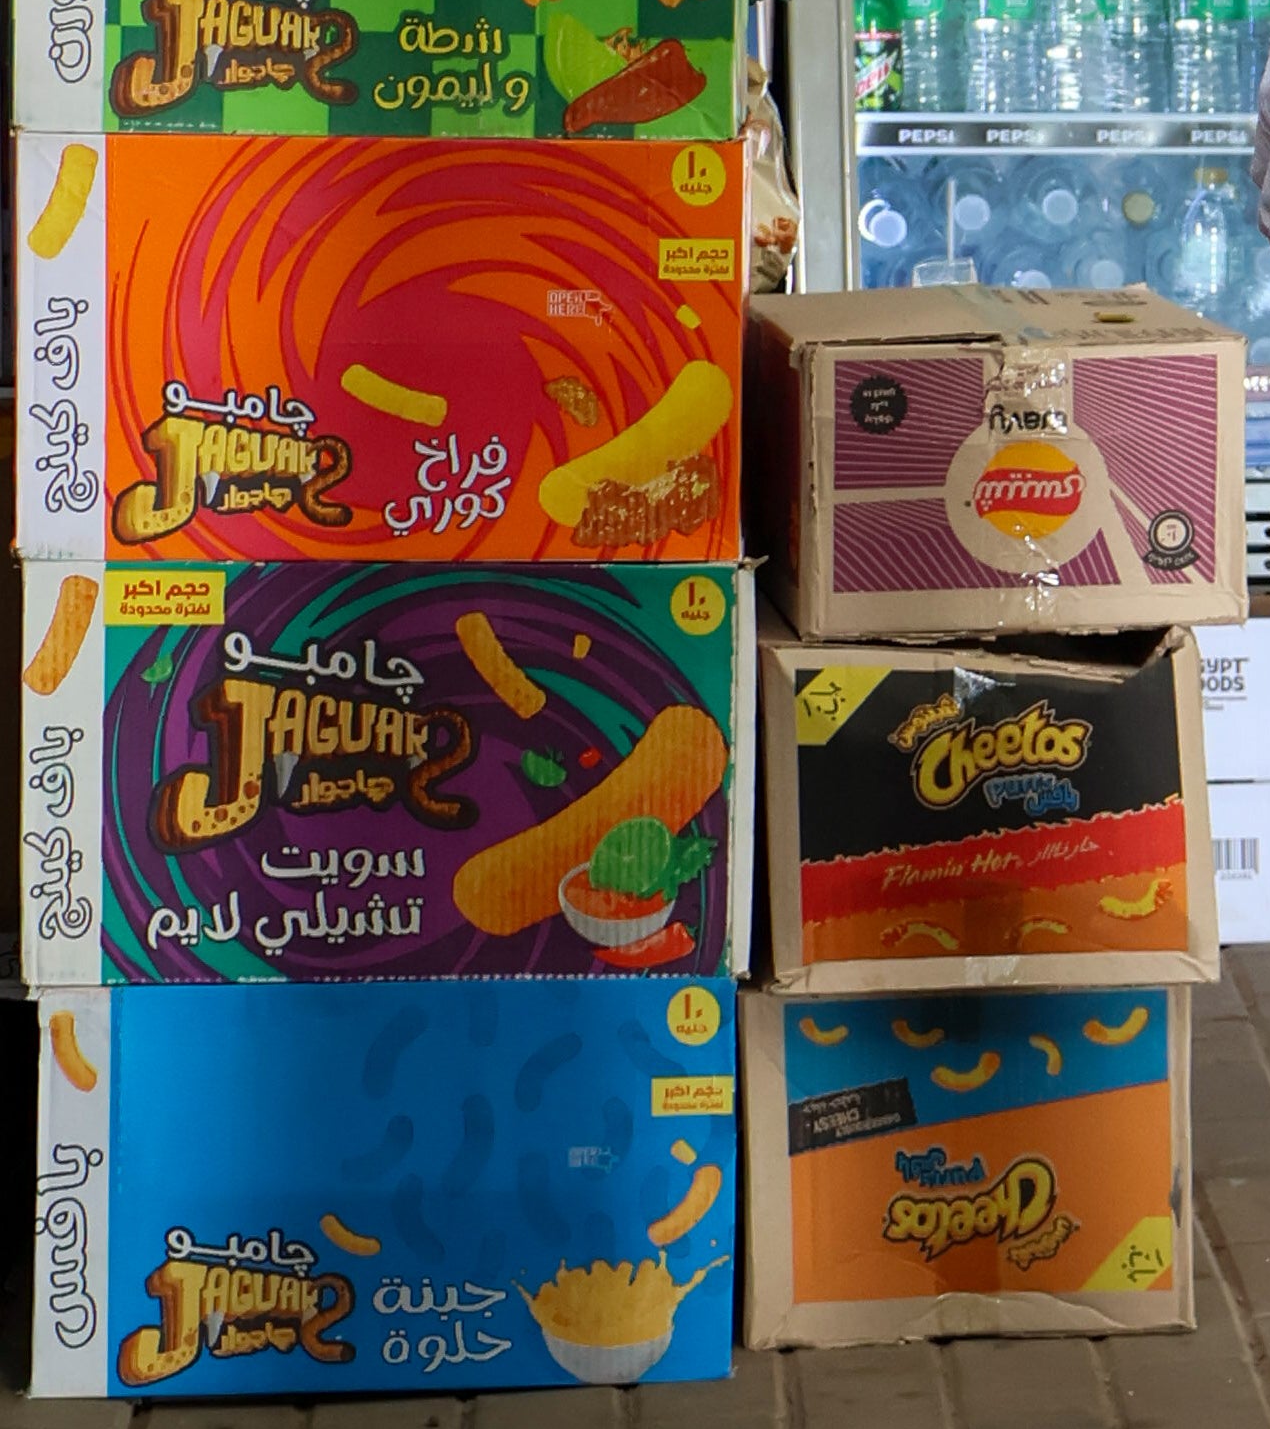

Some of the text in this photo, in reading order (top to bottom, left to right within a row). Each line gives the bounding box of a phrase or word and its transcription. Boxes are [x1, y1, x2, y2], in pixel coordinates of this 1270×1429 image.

[372, 61, 493, 111] ليمون
[112, 417, 322, 544] JAGUAR
[412, 434, 509, 493] فراخ
[382, 476, 513, 537] كوري
[163, 582, 211, 602] حجم
[154, 678, 432, 852] JAGUAR
[910, 699, 1094, 811] Cheetos
[261, 845, 427, 889] سويت
[147, 893, 242, 950] لايم
[883, 1155, 1060, 1262] Cheetos
[119, 1261, 322, 1387] JAGUAR
[371, 1274, 507, 1322] جبنة
[382, 1321, 513, 1374] حلوة
